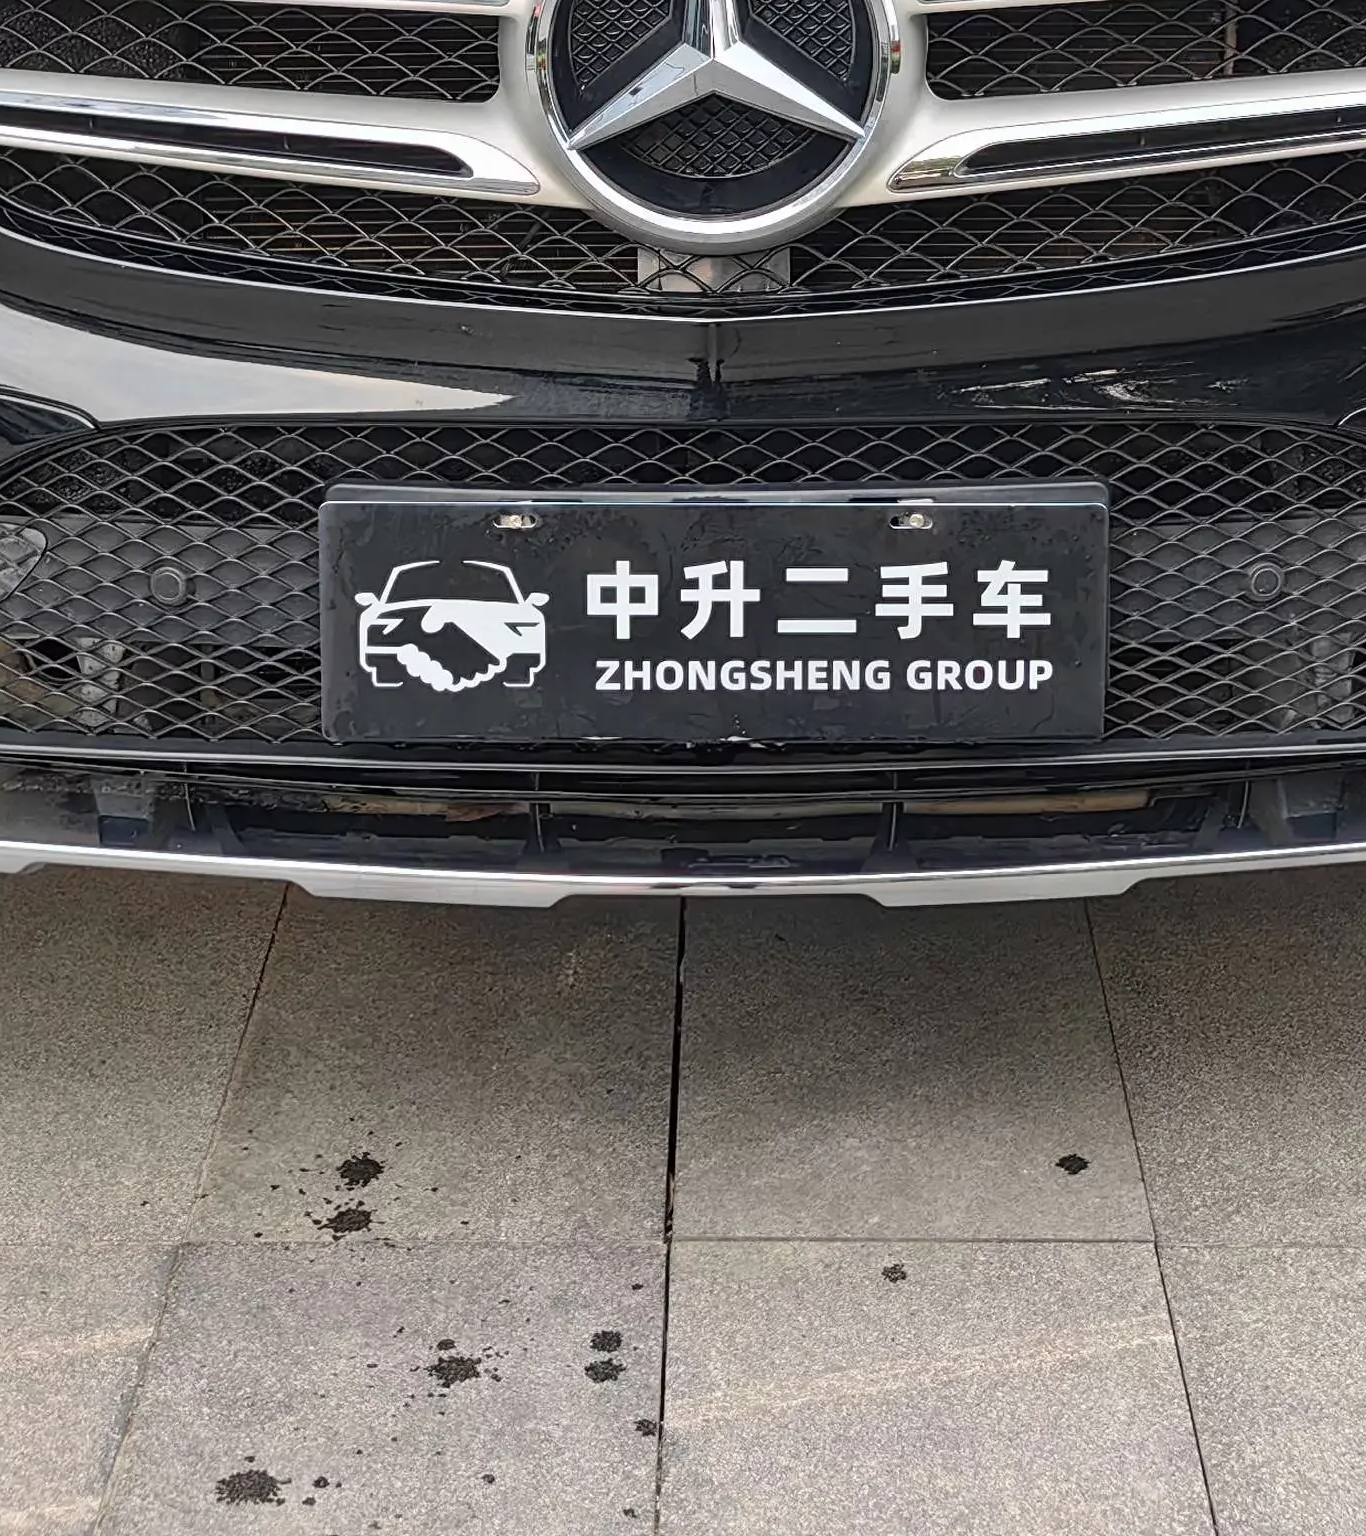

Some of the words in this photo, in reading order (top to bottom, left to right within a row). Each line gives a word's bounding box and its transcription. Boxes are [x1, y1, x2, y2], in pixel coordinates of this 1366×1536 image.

[587, 560, 1051, 639] 中升二手车
[596, 660, 890, 690] ZHONGSHENG
[907, 660, 1052, 690] GROUP
